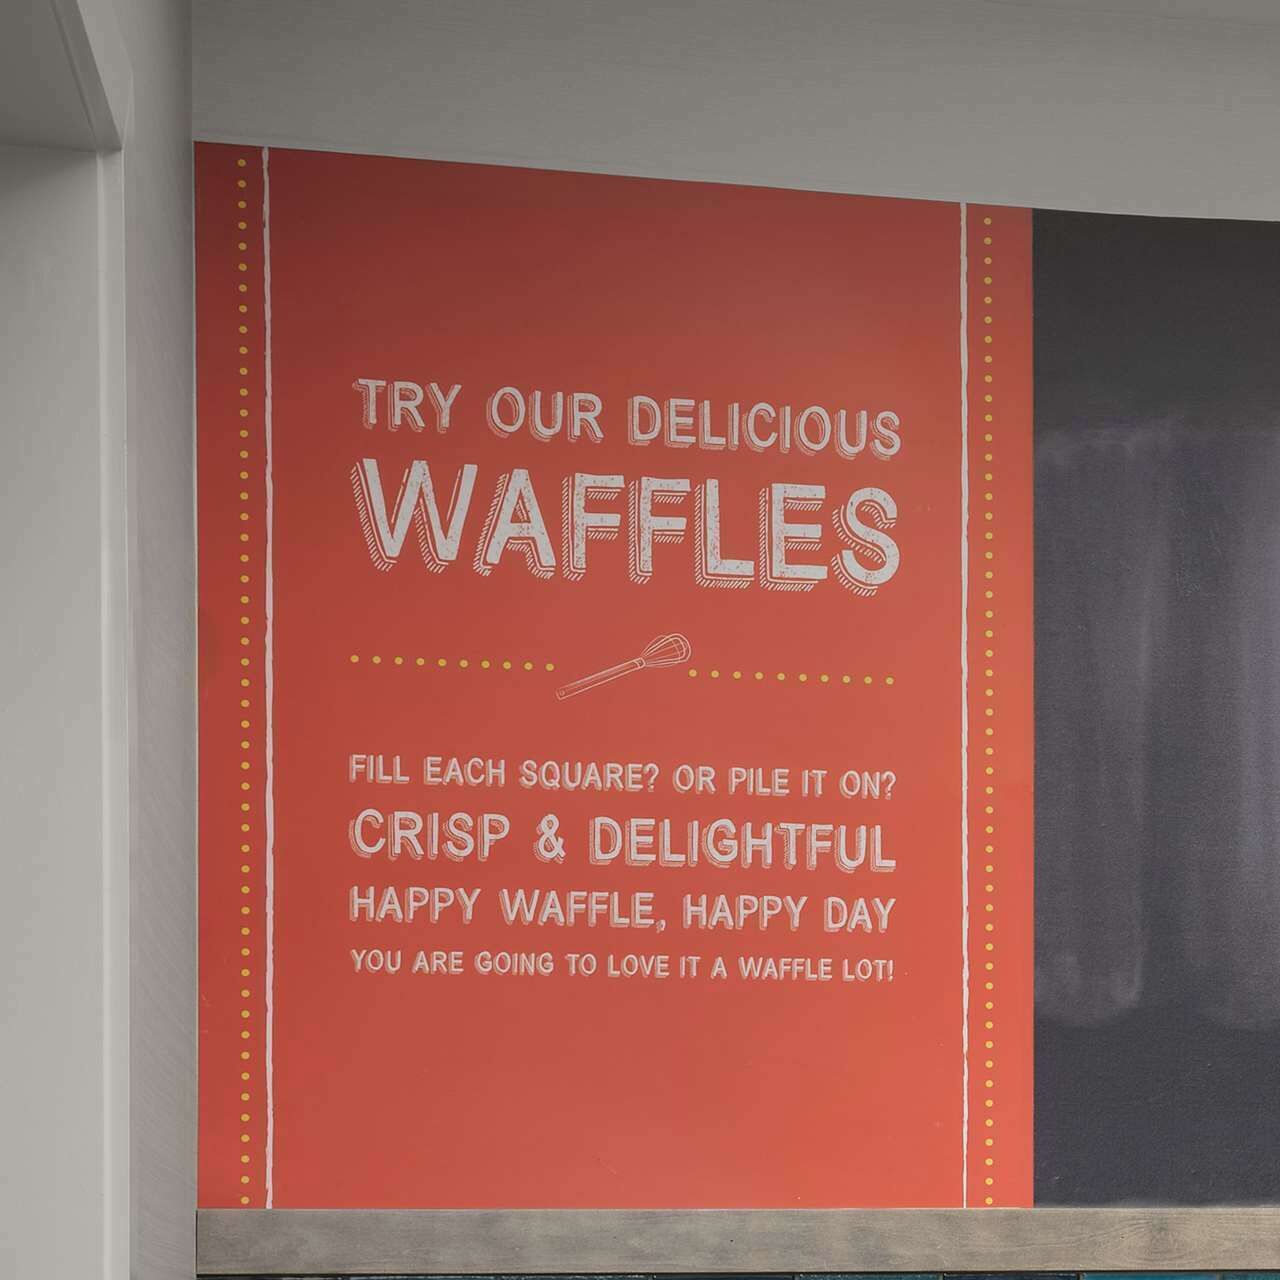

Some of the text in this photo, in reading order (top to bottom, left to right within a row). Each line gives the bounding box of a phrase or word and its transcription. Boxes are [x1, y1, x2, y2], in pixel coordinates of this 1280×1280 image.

[352, 378, 901, 459] TRY OUR DELICIOUS
[350, 458, 901, 597] WAFFLES
[349, 753, 896, 799] FILL EACH SQUARE? OR PILE IT ON?
[349, 808, 896, 872] CRISP & DELIGHTFUL
[350, 886, 895, 933] HAPPY WAFFLE, HAPPY DAY
[351, 949, 894, 983] YOU ARE GOING TO LOVE IT A WAFFLE LOT!
